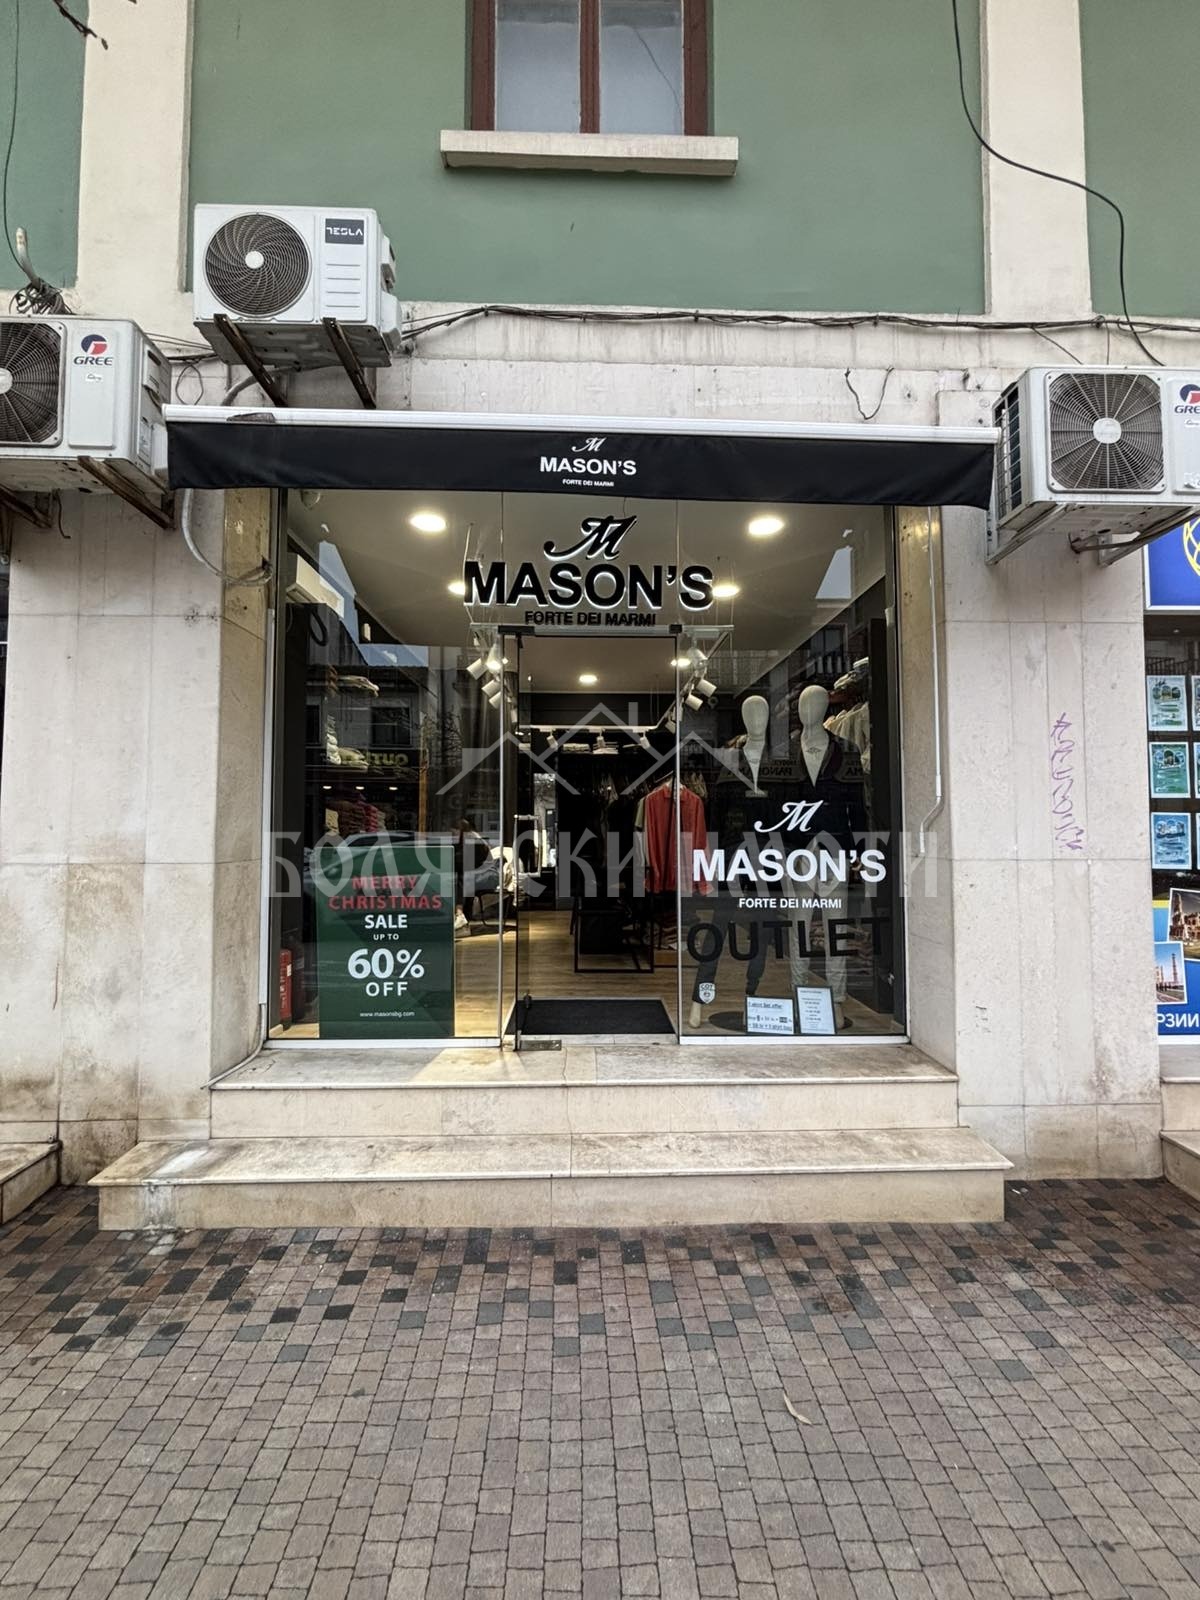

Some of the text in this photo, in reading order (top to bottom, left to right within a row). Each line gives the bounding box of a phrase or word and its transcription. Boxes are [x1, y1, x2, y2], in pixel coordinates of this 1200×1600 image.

[326, 226, 363, 236] TESLA
[73, 355, 113, 366] GREE
[540, 456, 637, 476] MASON'S
[463, 560, 714, 611] MASON'S
[525, 611, 656, 627] FORTE DEI MARMI
[692, 848, 887, 883] MASON'S
[352, 875, 417, 889] MERRY
[328, 895, 442, 910] CHRISTMAS
[738, 898, 842, 909] FORTE DEI MARMI
[364, 914, 408, 929] SALE
[373, 933, 400, 941] UP TO
[687, 916, 892, 963] OUTLET
[347, 948, 425, 979] 60%
[365, 981, 408, 997] OFF
